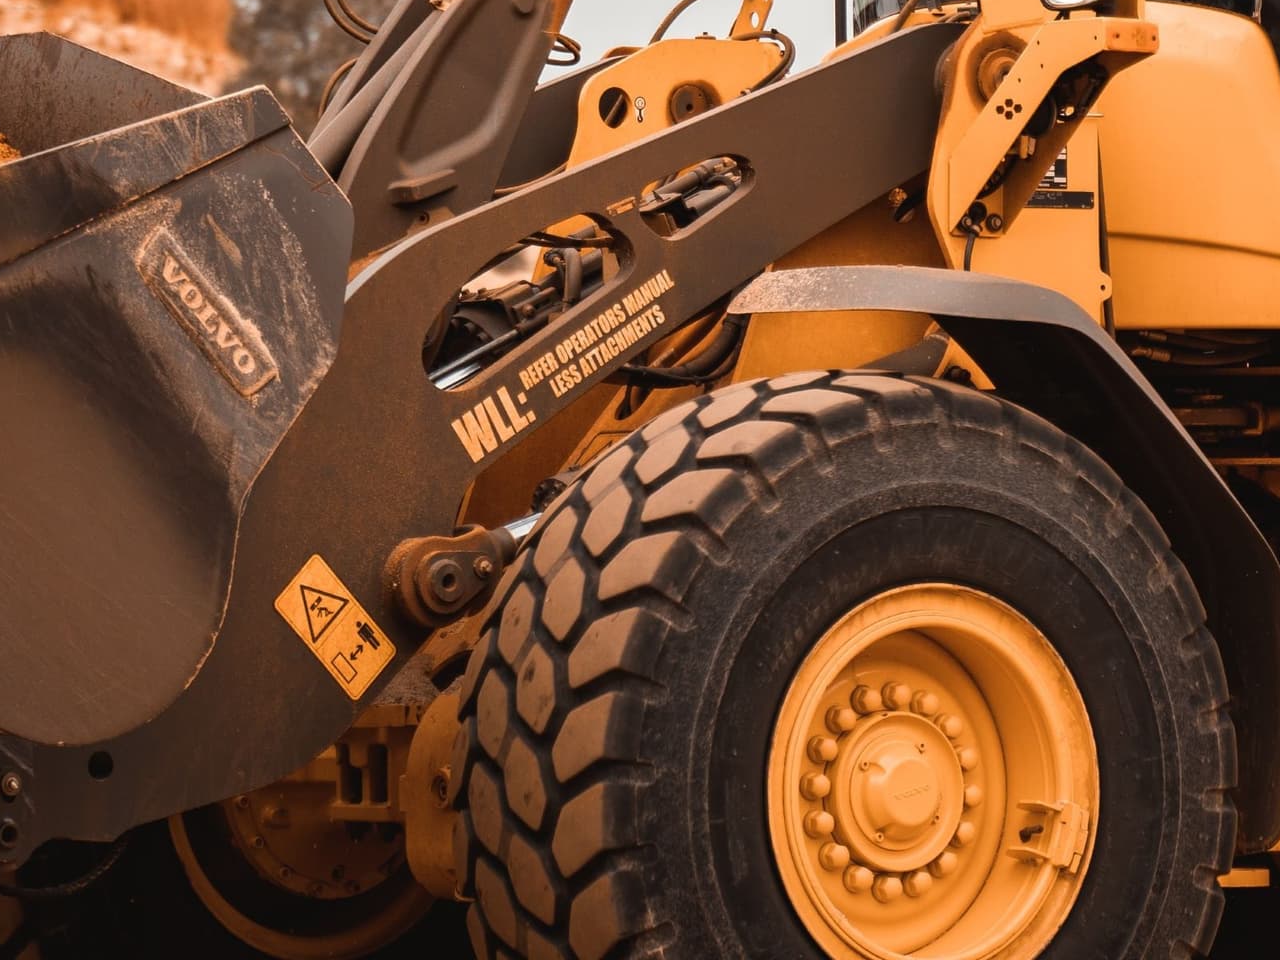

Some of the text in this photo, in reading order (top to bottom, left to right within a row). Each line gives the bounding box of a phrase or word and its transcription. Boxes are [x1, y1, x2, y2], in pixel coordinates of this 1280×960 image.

[162, 250, 256, 374] VOLVO
[451, 268, 675, 464] WLL: REFER OPERATORS MANUAL
[549, 304, 666, 398] LESS ATTACHMENTS
